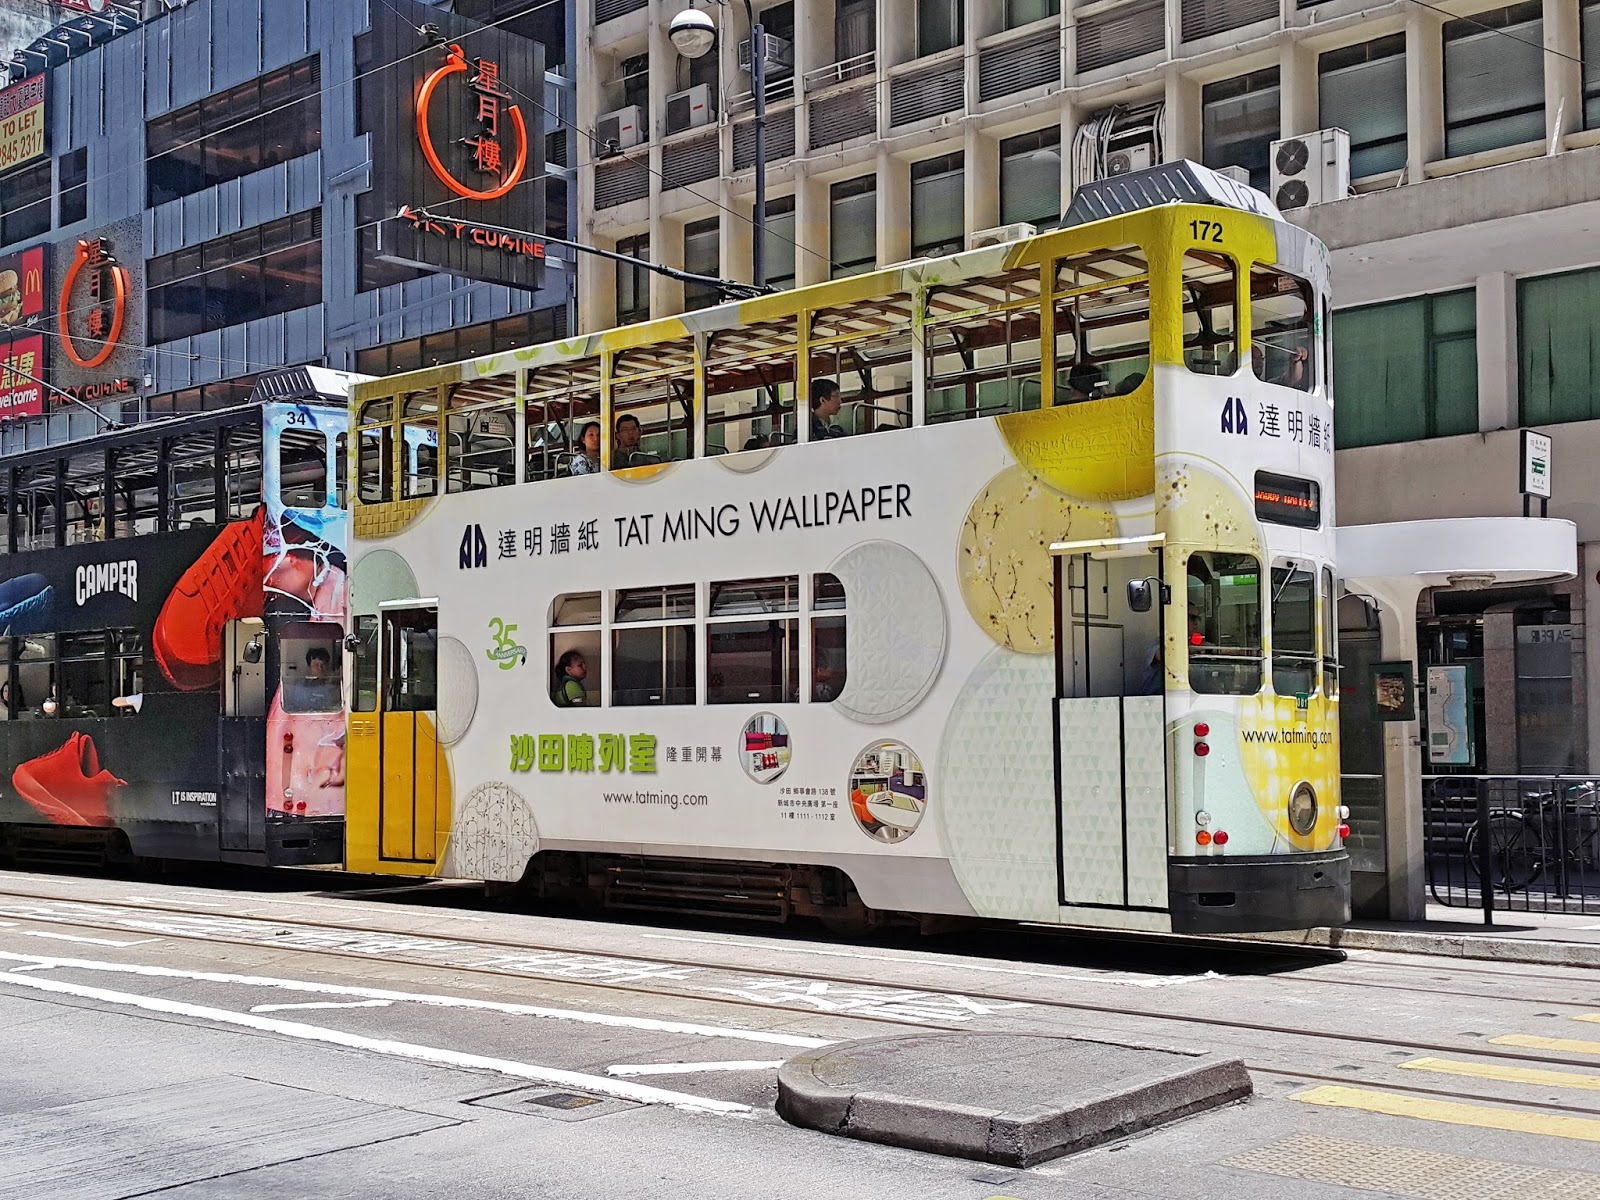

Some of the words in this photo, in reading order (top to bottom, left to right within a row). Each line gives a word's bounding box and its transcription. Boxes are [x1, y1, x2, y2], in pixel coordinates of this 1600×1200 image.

[2, 119, 16, 139] TO
[19, 109, 37, 133] LET
[0, 139, 18, 168] 845
[20, 128, 43, 159] 2317
[471, 228, 545, 259] CUISINE
[1190, 219, 1223, 243] 172
[85, 377, 129, 400] CUISINE
[286, 411, 306, 426] 34
[426, 429, 437, 443] 34
[614, 513, 654, 548] TAT
[662, 504, 740, 543] MING
[749, 484, 913, 534] WALLPAPER
[497, 518, 600, 560] 達明牆紙
[75, 559, 138, 606] CAMPER
[486, 617, 518, 671] 35
[509, 732, 657, 773] 沙田陳列室
[666, 745, 723, 763] 隆重開幕
[181, 792, 186, 801] IS
[186, 792, 216, 802] INSPIRATION
[602, 789, 709, 810] www.tatming.com
